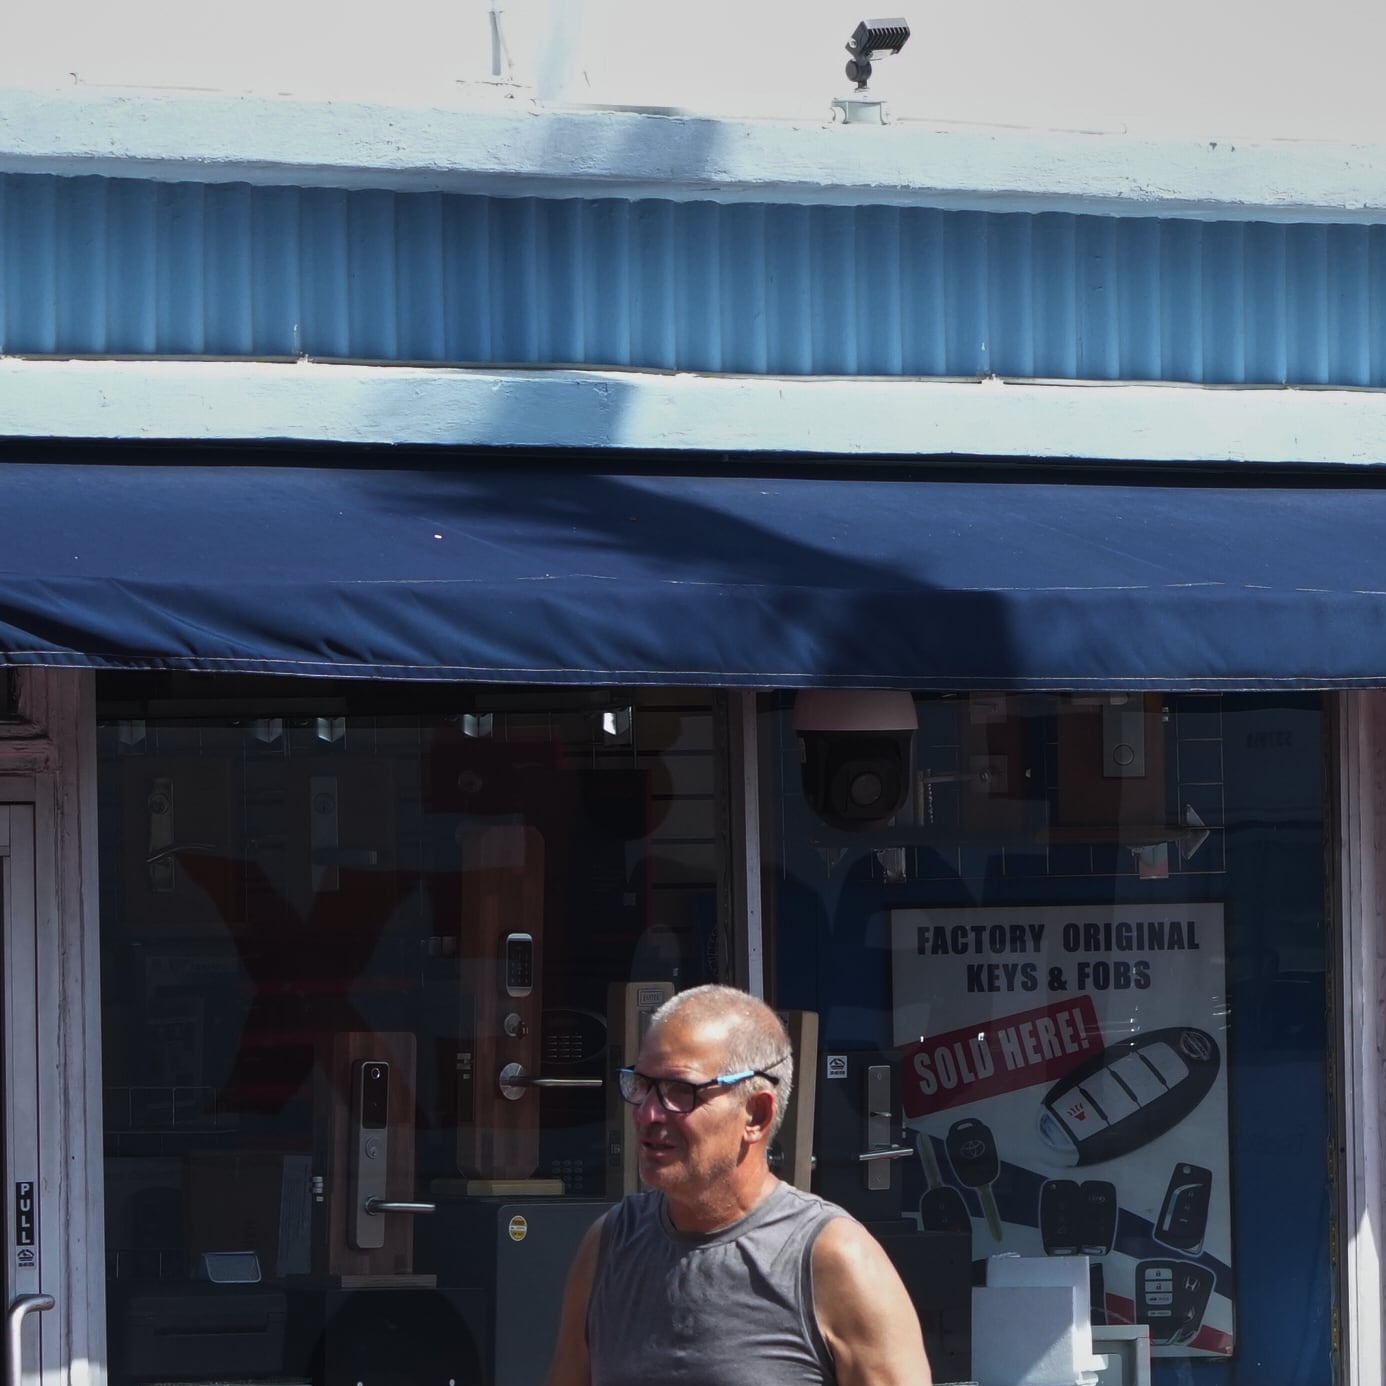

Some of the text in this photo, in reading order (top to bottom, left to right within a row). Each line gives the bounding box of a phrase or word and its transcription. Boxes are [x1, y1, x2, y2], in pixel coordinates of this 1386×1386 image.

[917, 921, 1200, 955] FACTORY ORIGINAL
[966, 960, 1151, 993] KEYS & FOBS
[913, 1007, 1090, 1096] SOLD HERE!
[20, 1183, 31, 1244] PULL
